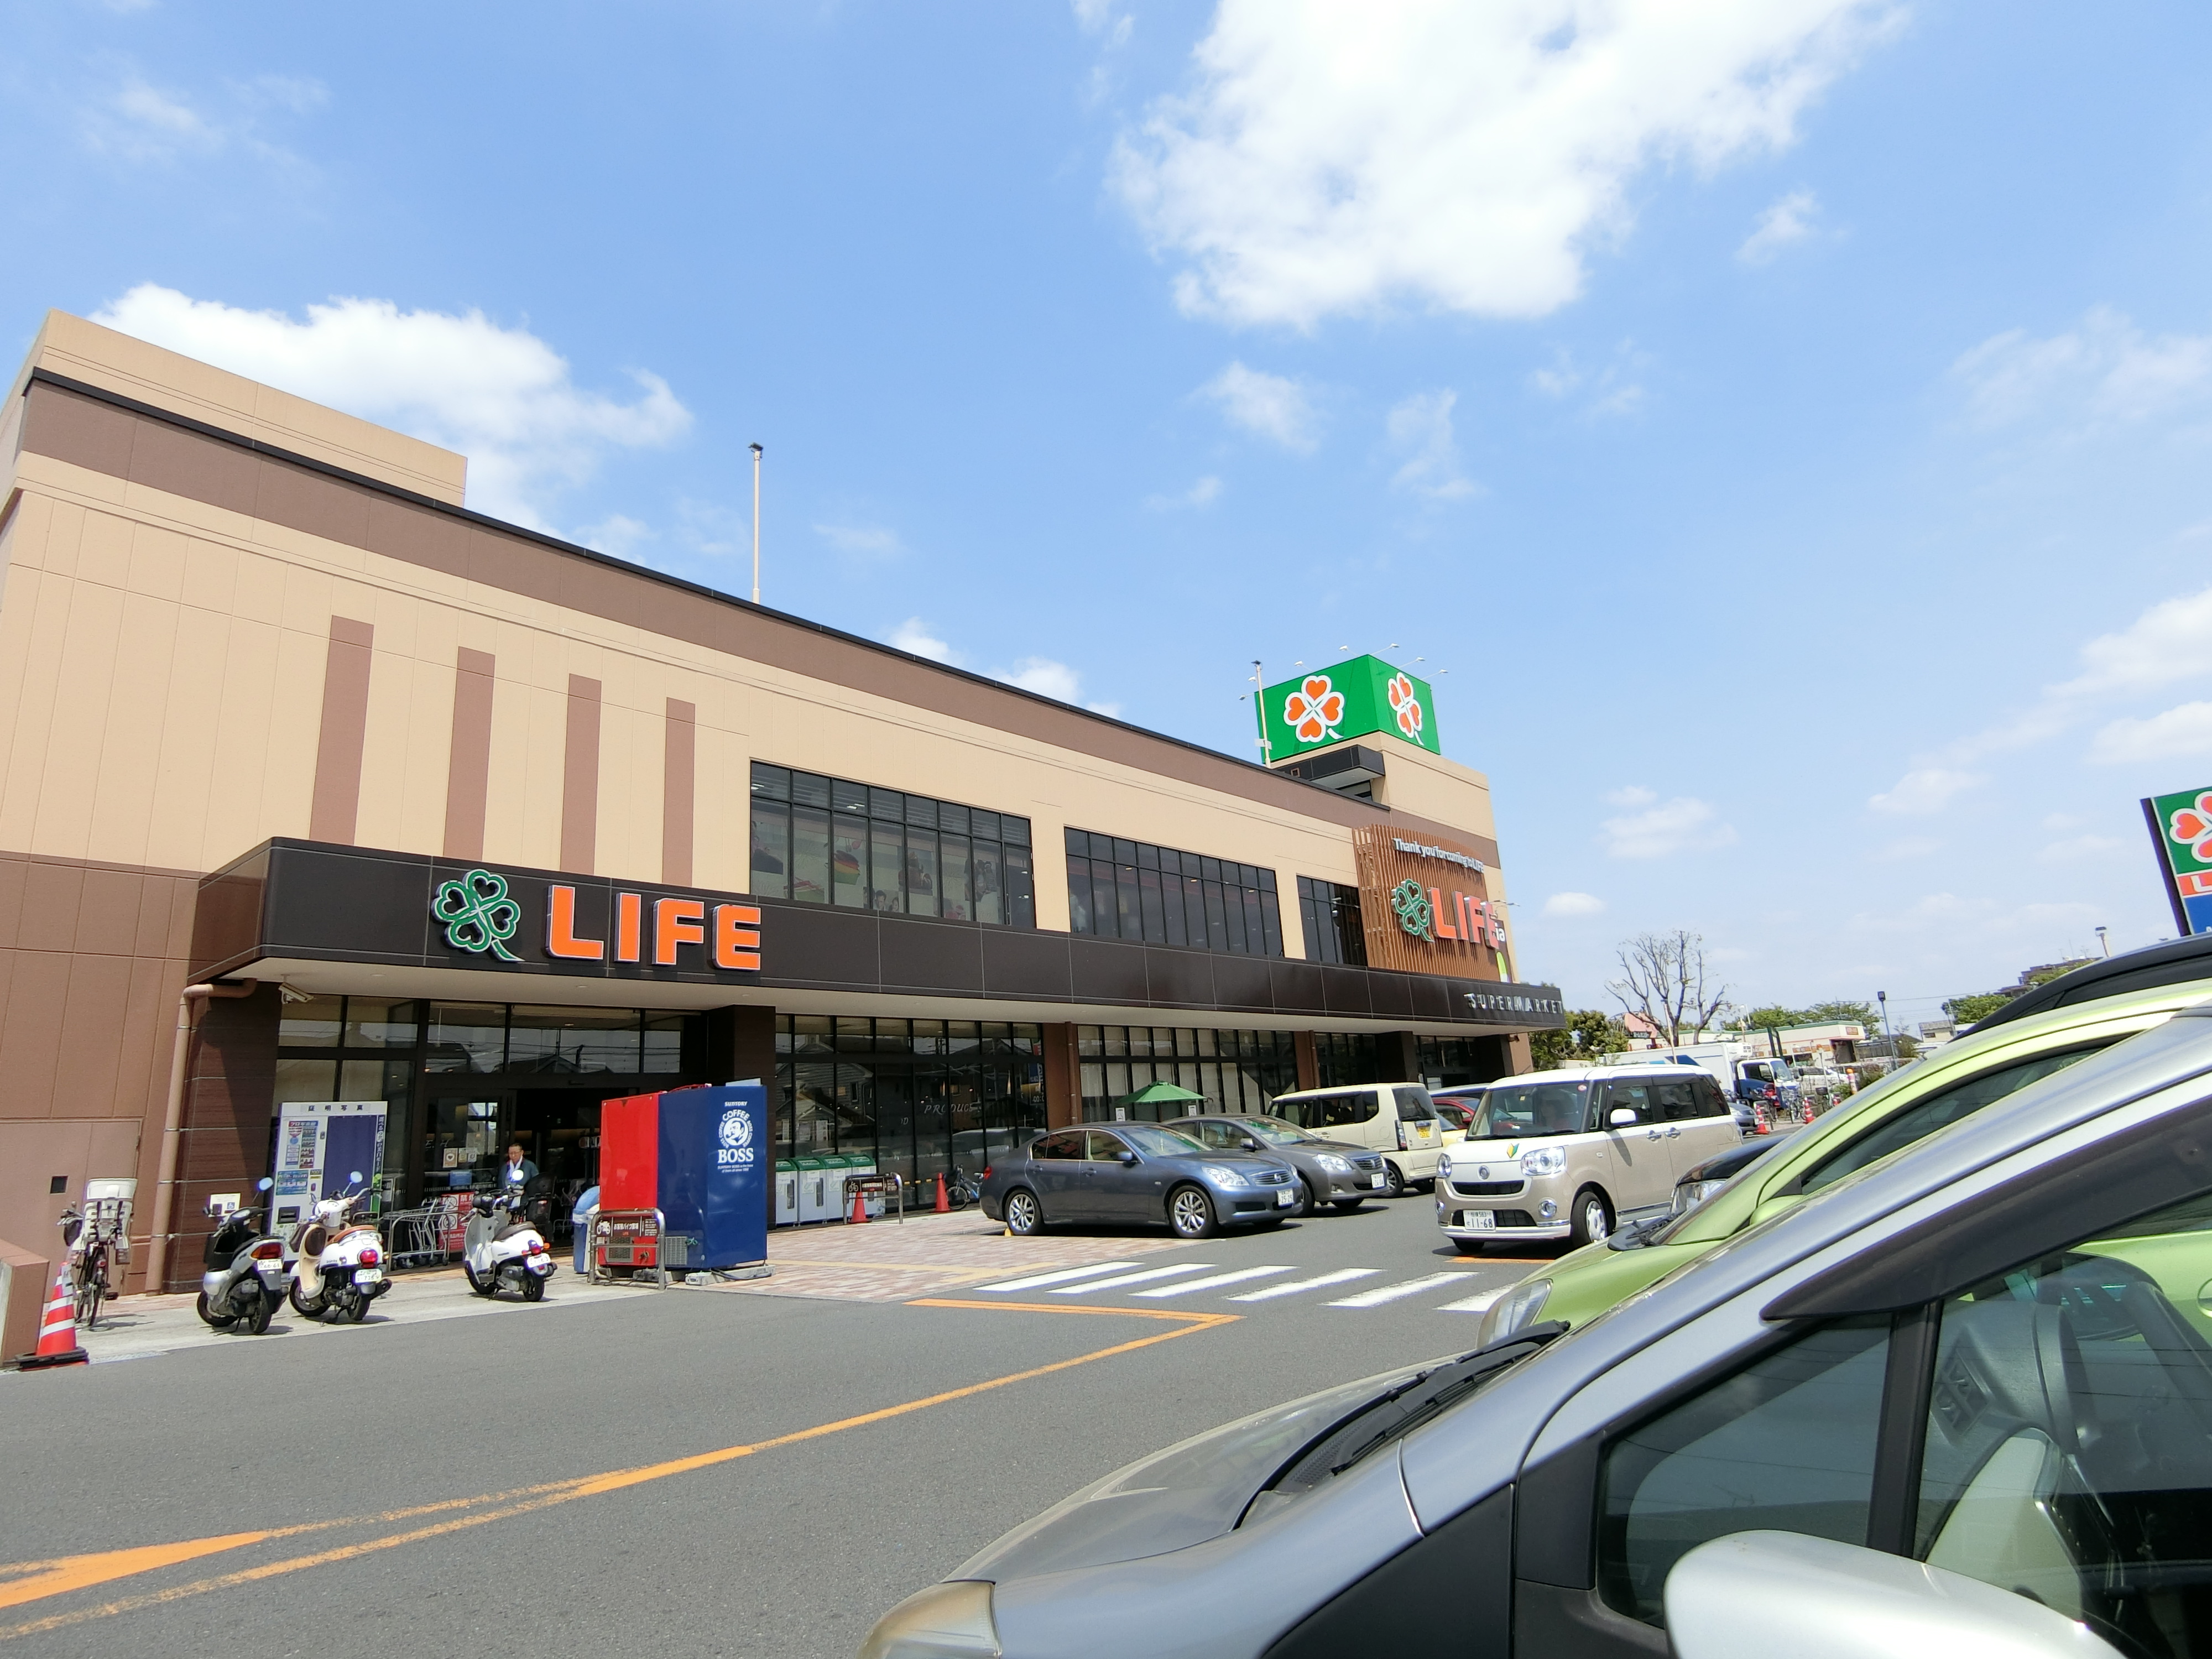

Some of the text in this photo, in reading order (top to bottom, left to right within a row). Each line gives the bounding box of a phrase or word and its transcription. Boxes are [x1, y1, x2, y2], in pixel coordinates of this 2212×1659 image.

[1392, 837, 1421, 854] Thank
[1421, 845, 1436, 858] you
[1436, 847, 1447, 859] for
[1446, 852, 1468, 868] coming
[545, 885, 761, 971] LIFE
[1427, 887, 1499, 949] LIFE
[1464, 993, 1563, 1014] SUPERMARKET
[723, 1109, 750, 1121] COFFEE
[718, 1147, 754, 1163] BOSS
[1472, 1218, 1493, 1228] 11-68
